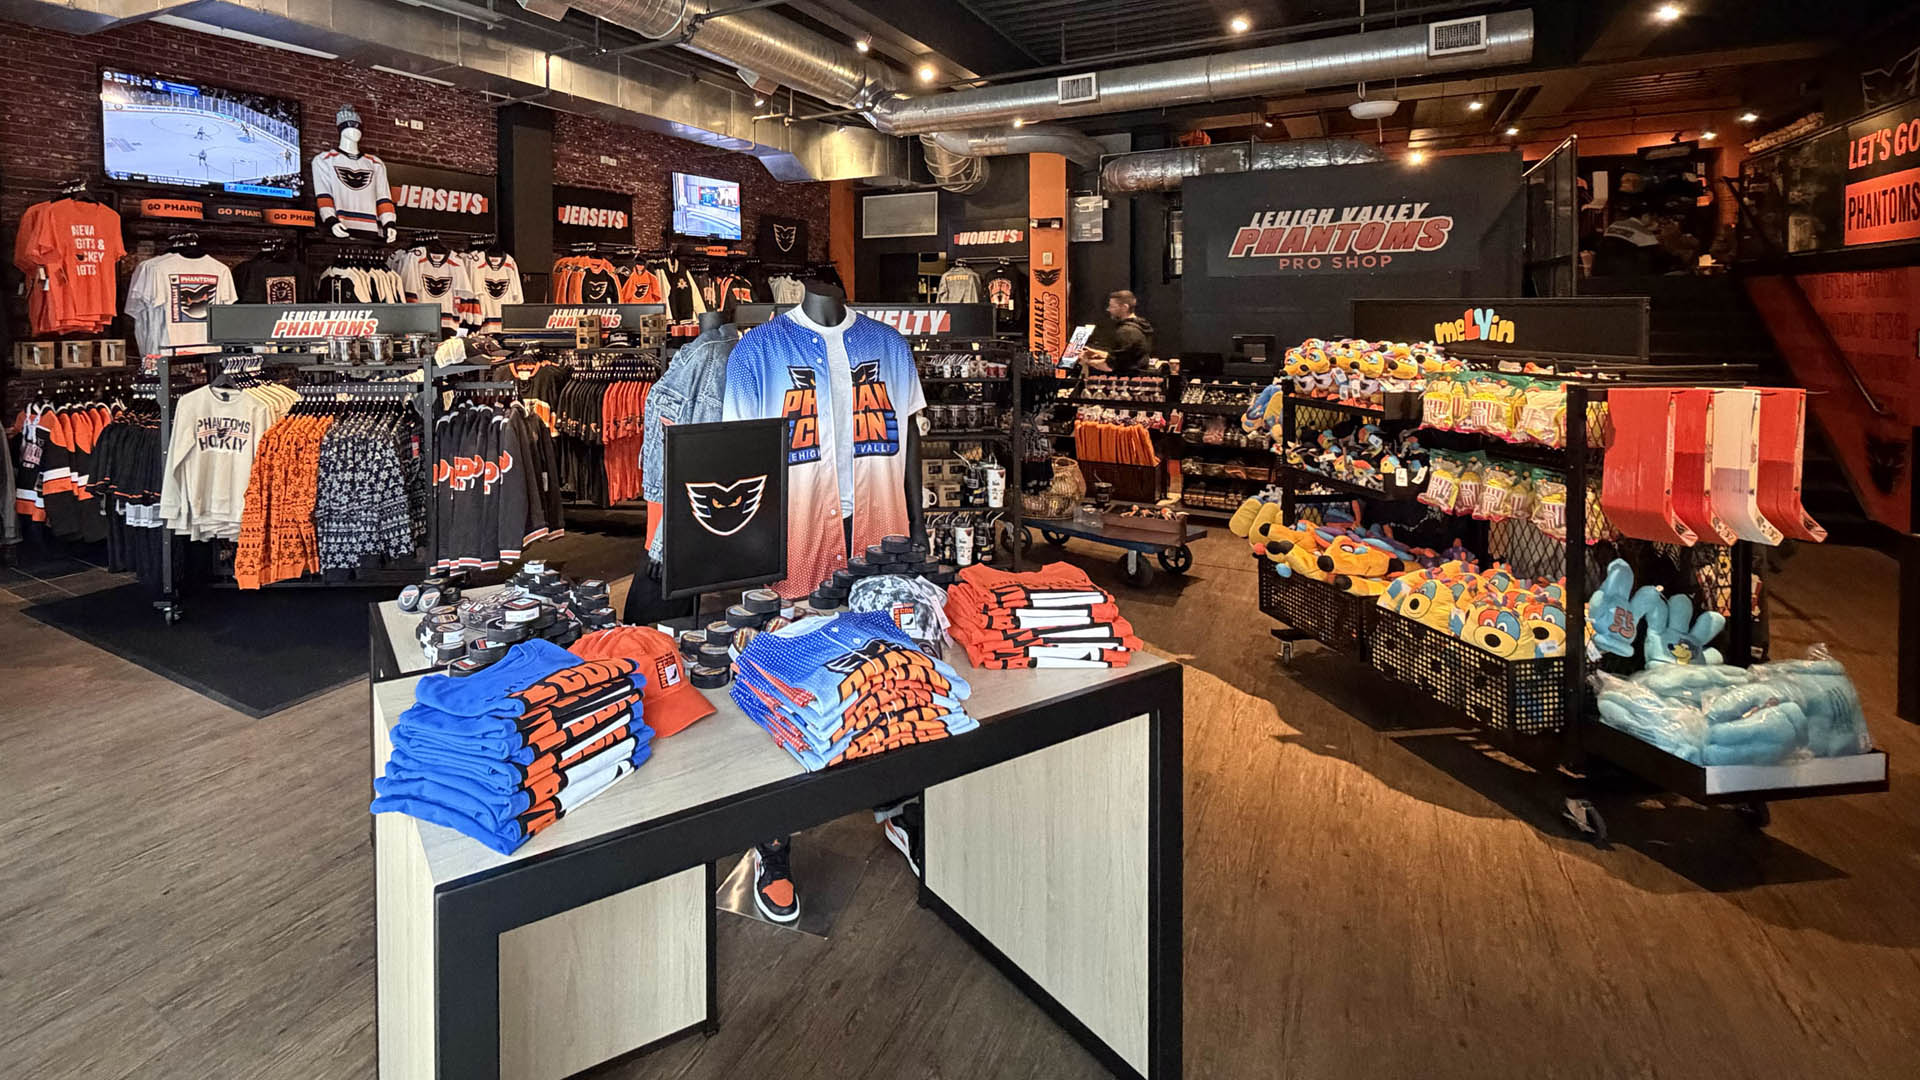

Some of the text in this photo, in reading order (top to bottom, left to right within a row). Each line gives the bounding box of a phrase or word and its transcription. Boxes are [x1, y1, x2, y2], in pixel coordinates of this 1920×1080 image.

[1848, 118, 1920, 170] LET'S GO
[147, 203, 161, 211] GO
[396, 184, 483, 215] JERSEYS
[1847, 181, 1920, 231] PHANTOMS
[217, 208, 233, 216] GO
[562, 205, 624, 229] JERSEYS
[1250, 202, 1430, 228] LEHIGH VALLEY
[958, 229, 1020, 246] WOMEN'S
[1228, 216, 1455, 258] PHANTOMS
[1279, 255, 1393, 270] PRO SHOP
[280, 310, 373, 322] LEHIGH VALLEY
[546, 314, 622, 328] PHAMS
[553, 308, 618, 316] LEHIGH VALLEY
[1034, 297, 1045, 339] VALLEY
[270, 319, 378, 339] PHANTOMS
[197, 417, 251, 434] PHANTOMS
